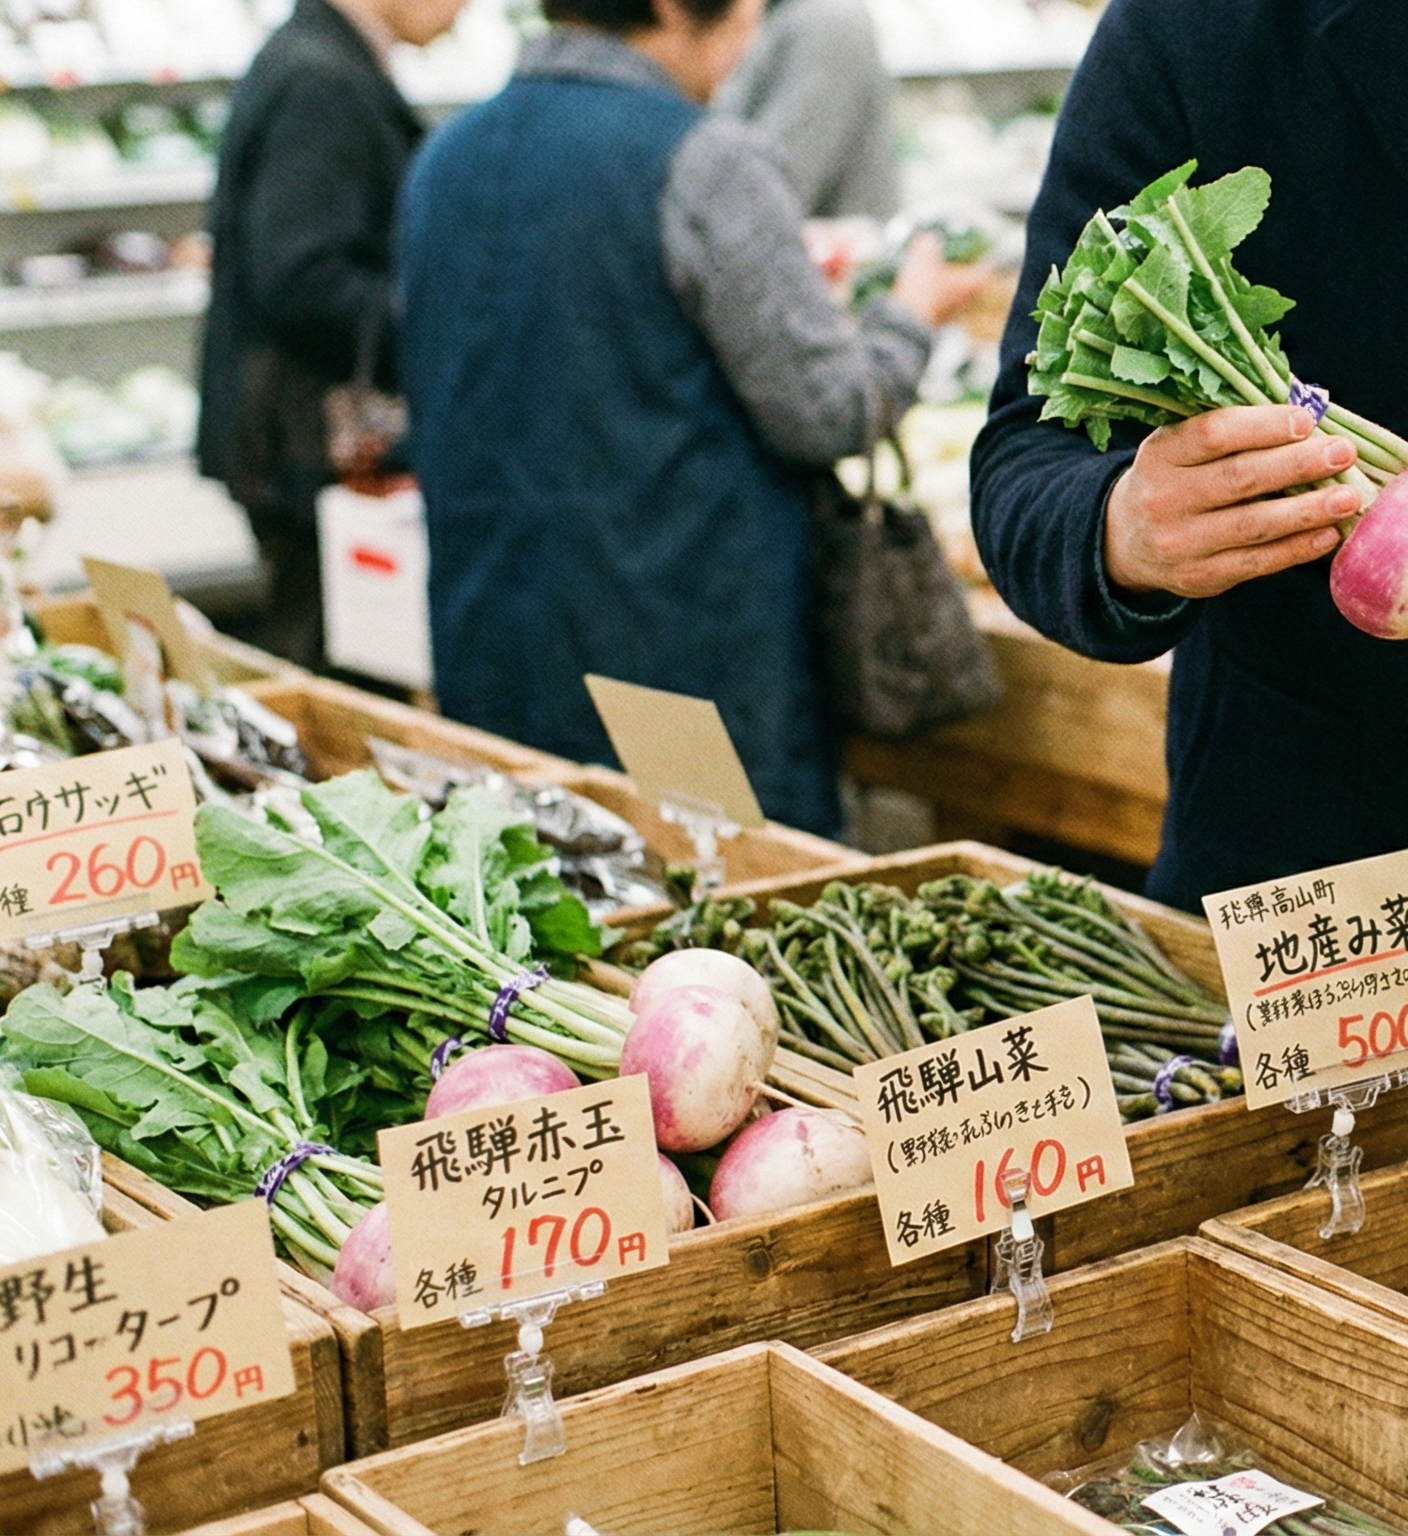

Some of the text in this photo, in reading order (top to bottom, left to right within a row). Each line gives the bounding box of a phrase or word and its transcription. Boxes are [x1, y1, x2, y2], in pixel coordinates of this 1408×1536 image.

[46, 835, 200, 905] 260円
[876, 1025, 1049, 1124] 飛騨山菜
[1255, 1043, 1316, 1090] 各種
[410, 1100, 626, 1191] 飛騨赤玉
[481, 1158, 604, 1220] タルニプ
[896, 1138, 1106, 1248] 各種 160円
[0, 1255, 118, 1333] 野生
[413, 1206, 647, 1310] 各種 170円
[102, 1346, 265, 1426] 350円
